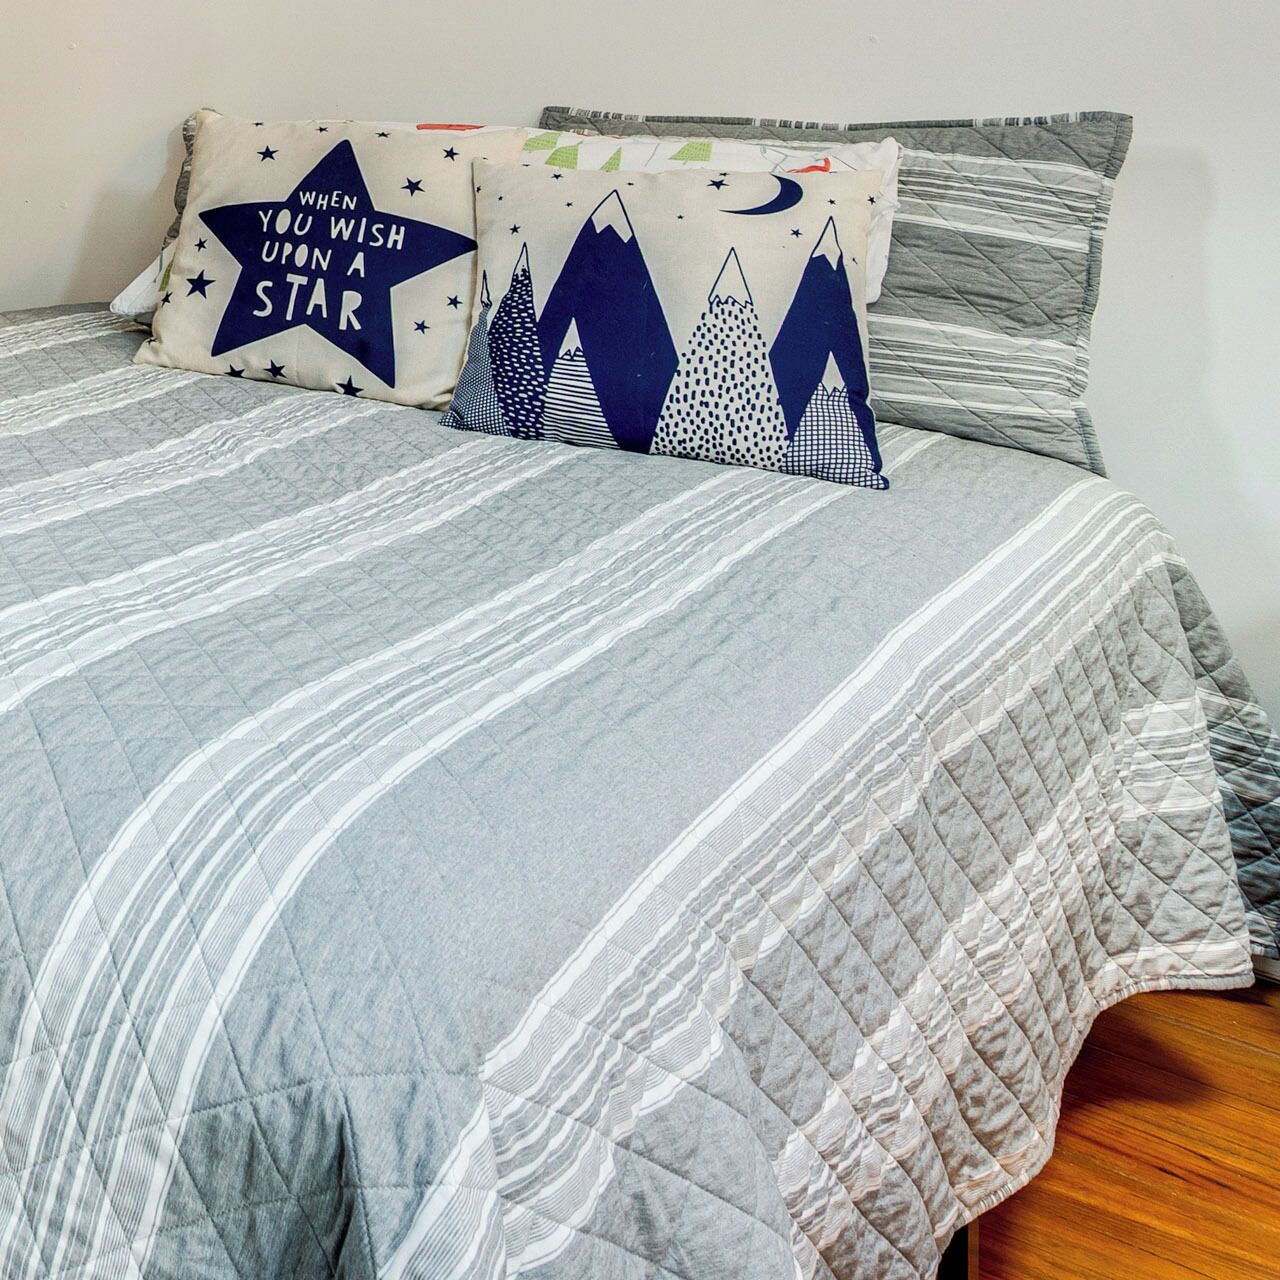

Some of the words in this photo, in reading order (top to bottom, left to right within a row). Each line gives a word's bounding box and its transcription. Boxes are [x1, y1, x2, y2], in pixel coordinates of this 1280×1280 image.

[299, 191, 357, 210] WHEN
[259, 209, 312, 236] YOU
[330, 216, 405, 250] WISH
[262, 241, 332, 271] UPON
[347, 252, 365, 277] A
[253, 274, 362, 330] STAR
